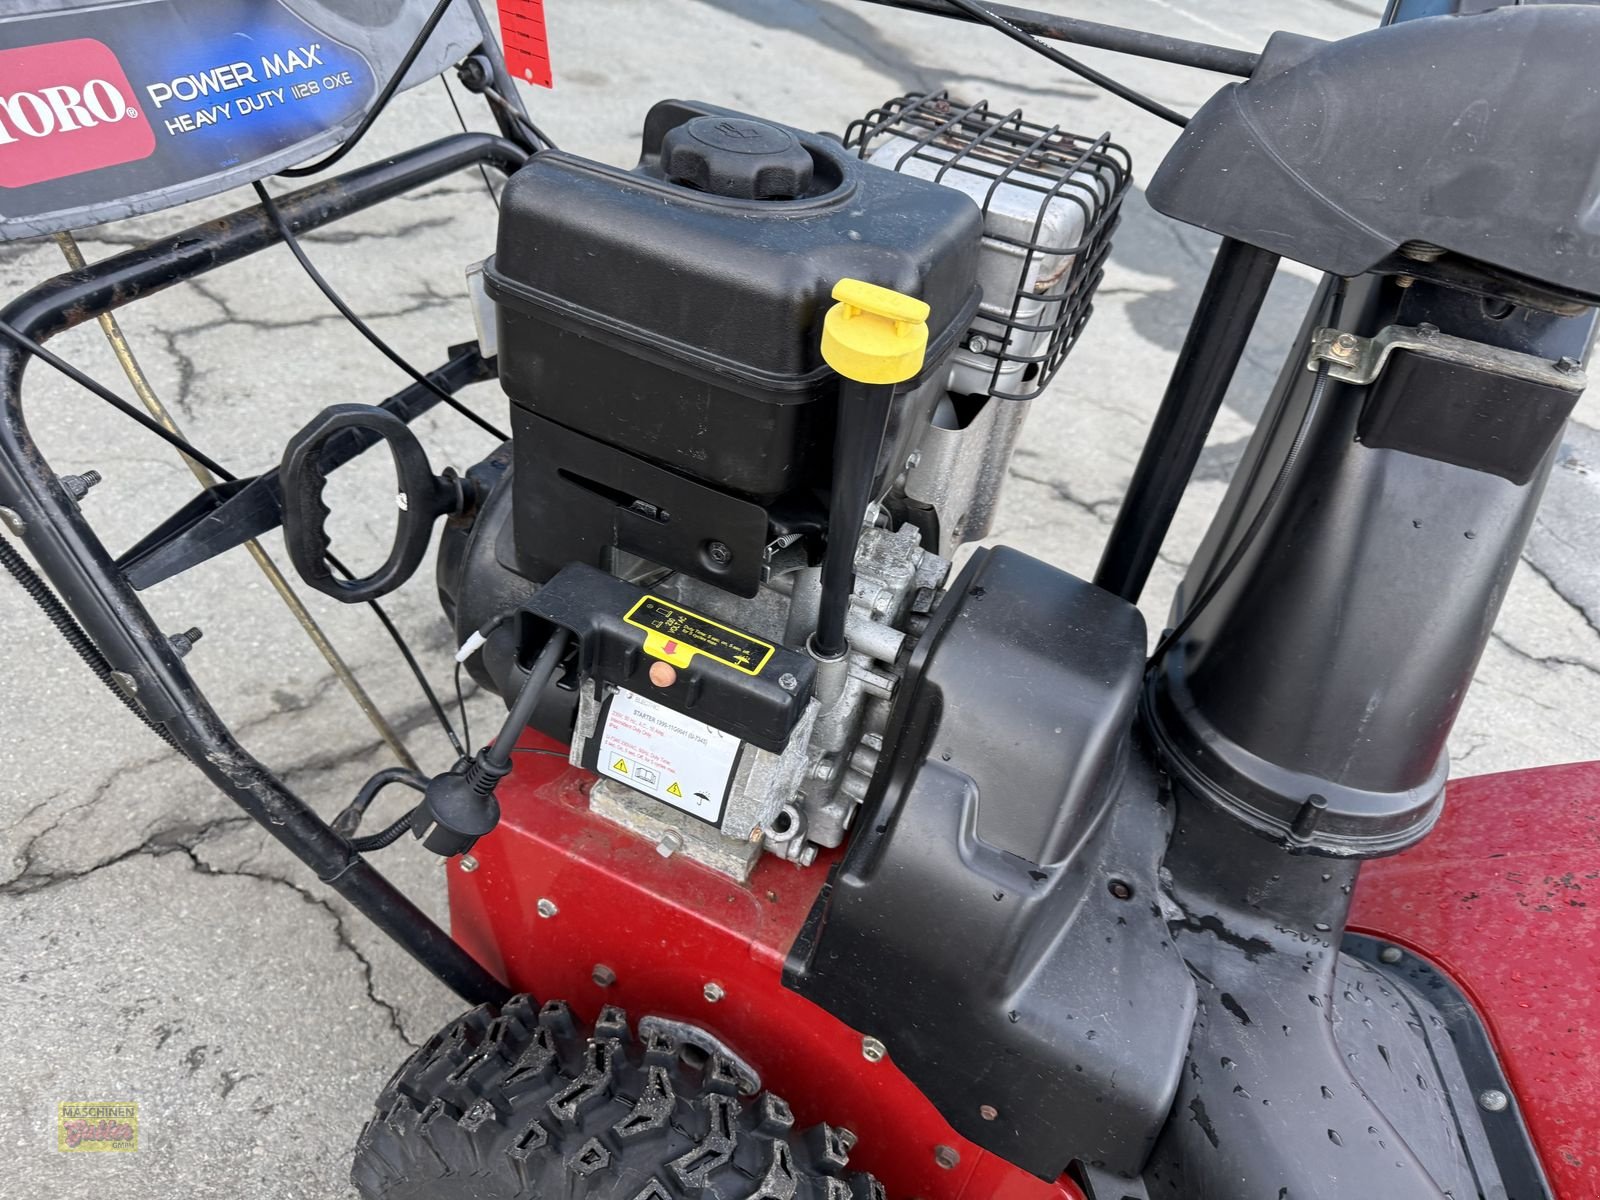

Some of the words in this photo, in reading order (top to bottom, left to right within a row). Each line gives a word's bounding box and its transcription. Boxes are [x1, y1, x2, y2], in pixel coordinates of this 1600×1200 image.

[146, 61, 258, 108] POWER
[261, 44, 323, 79] MAX
[164, 102, 232, 136] HEAVY
[235, 87, 285, 115] DUTY
[291, 80, 321, 100] 1128
[322, 71, 353, 90] OXE
[633, 709, 656, 722] STARTER
